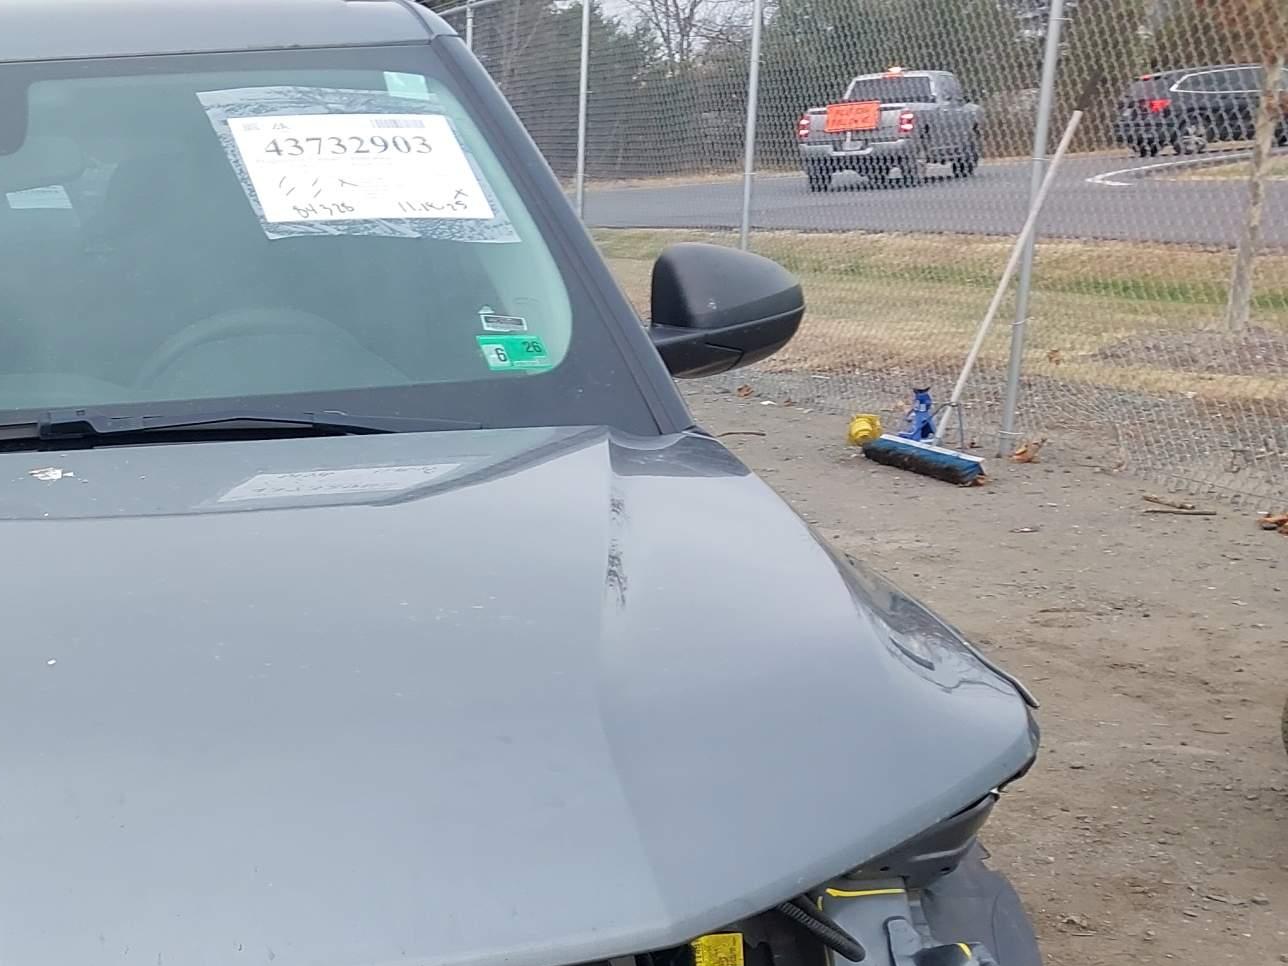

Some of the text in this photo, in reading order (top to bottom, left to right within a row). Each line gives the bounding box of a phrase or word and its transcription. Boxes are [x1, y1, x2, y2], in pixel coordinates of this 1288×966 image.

[265, 135, 433, 156] 43732903
[520, 340, 543, 353] 26
[494, 347, 508, 362] 6
